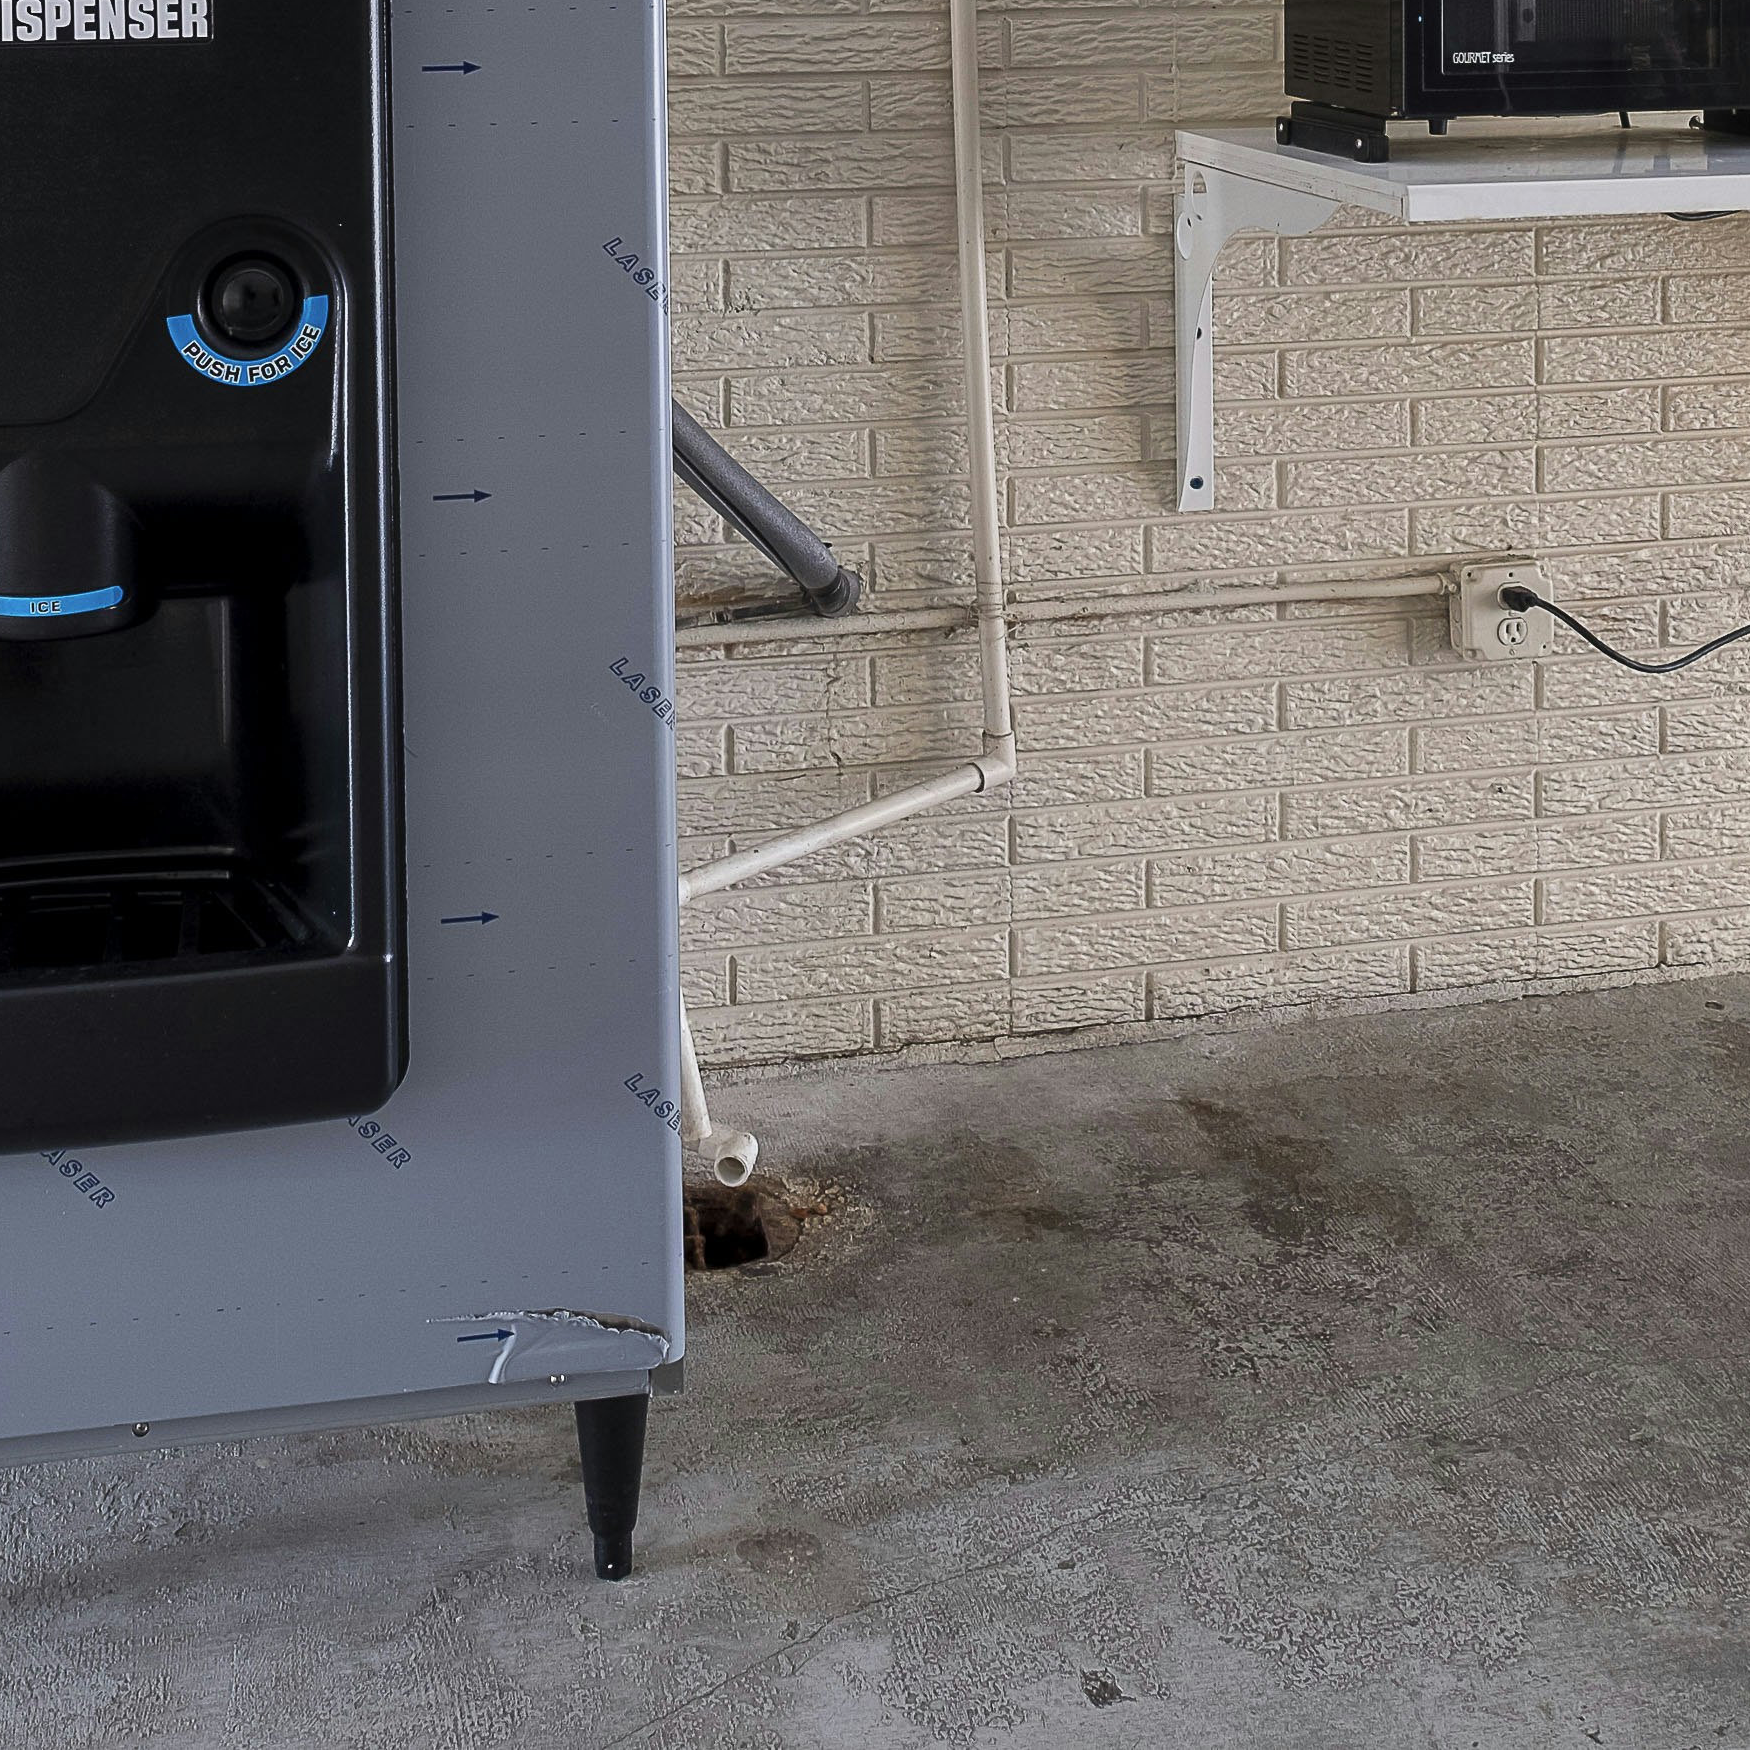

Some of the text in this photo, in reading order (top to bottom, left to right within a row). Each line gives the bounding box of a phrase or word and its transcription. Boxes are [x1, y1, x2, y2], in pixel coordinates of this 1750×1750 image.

[1452, 51, 1515, 64] GOURMET series
[181, 323, 322, 385] PUSH FOR ICE
[29, 600, 62, 614] ICE
[624, 1073, 682, 1138] LASE
